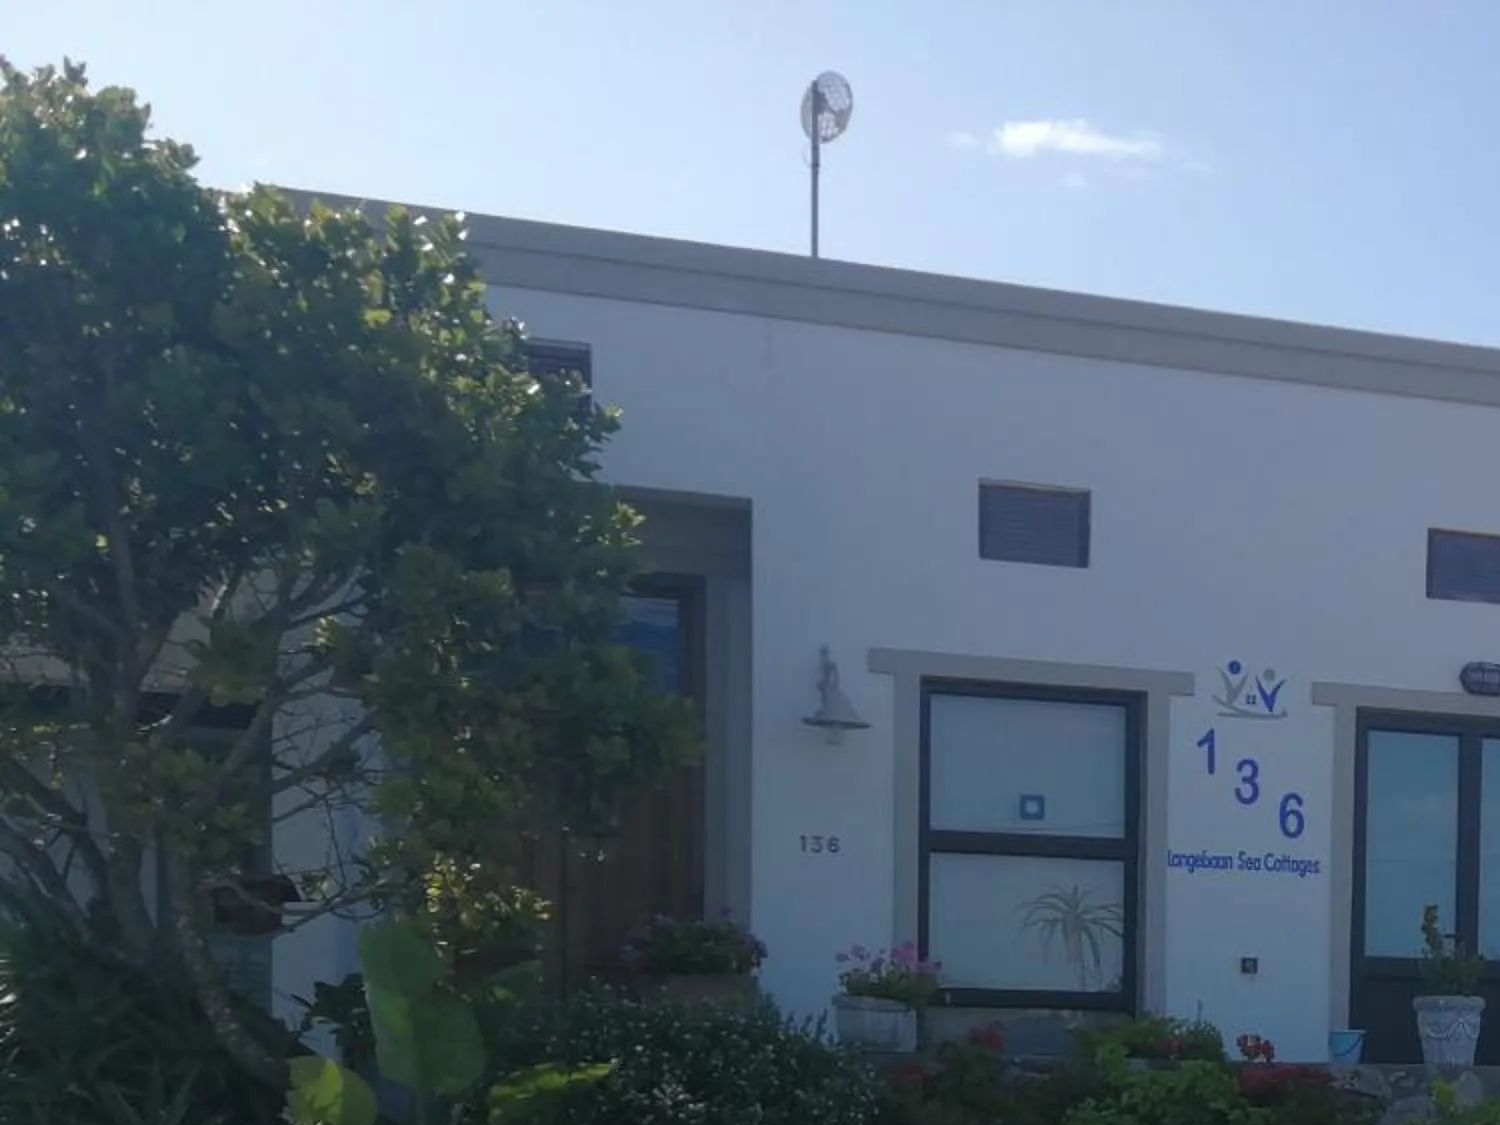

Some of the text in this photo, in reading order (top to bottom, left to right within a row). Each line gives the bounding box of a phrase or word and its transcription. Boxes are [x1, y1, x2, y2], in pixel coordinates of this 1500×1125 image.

[799, 834, 842, 854] 136
[1167, 849, 1321, 878] Langebaan Sea Cottages
